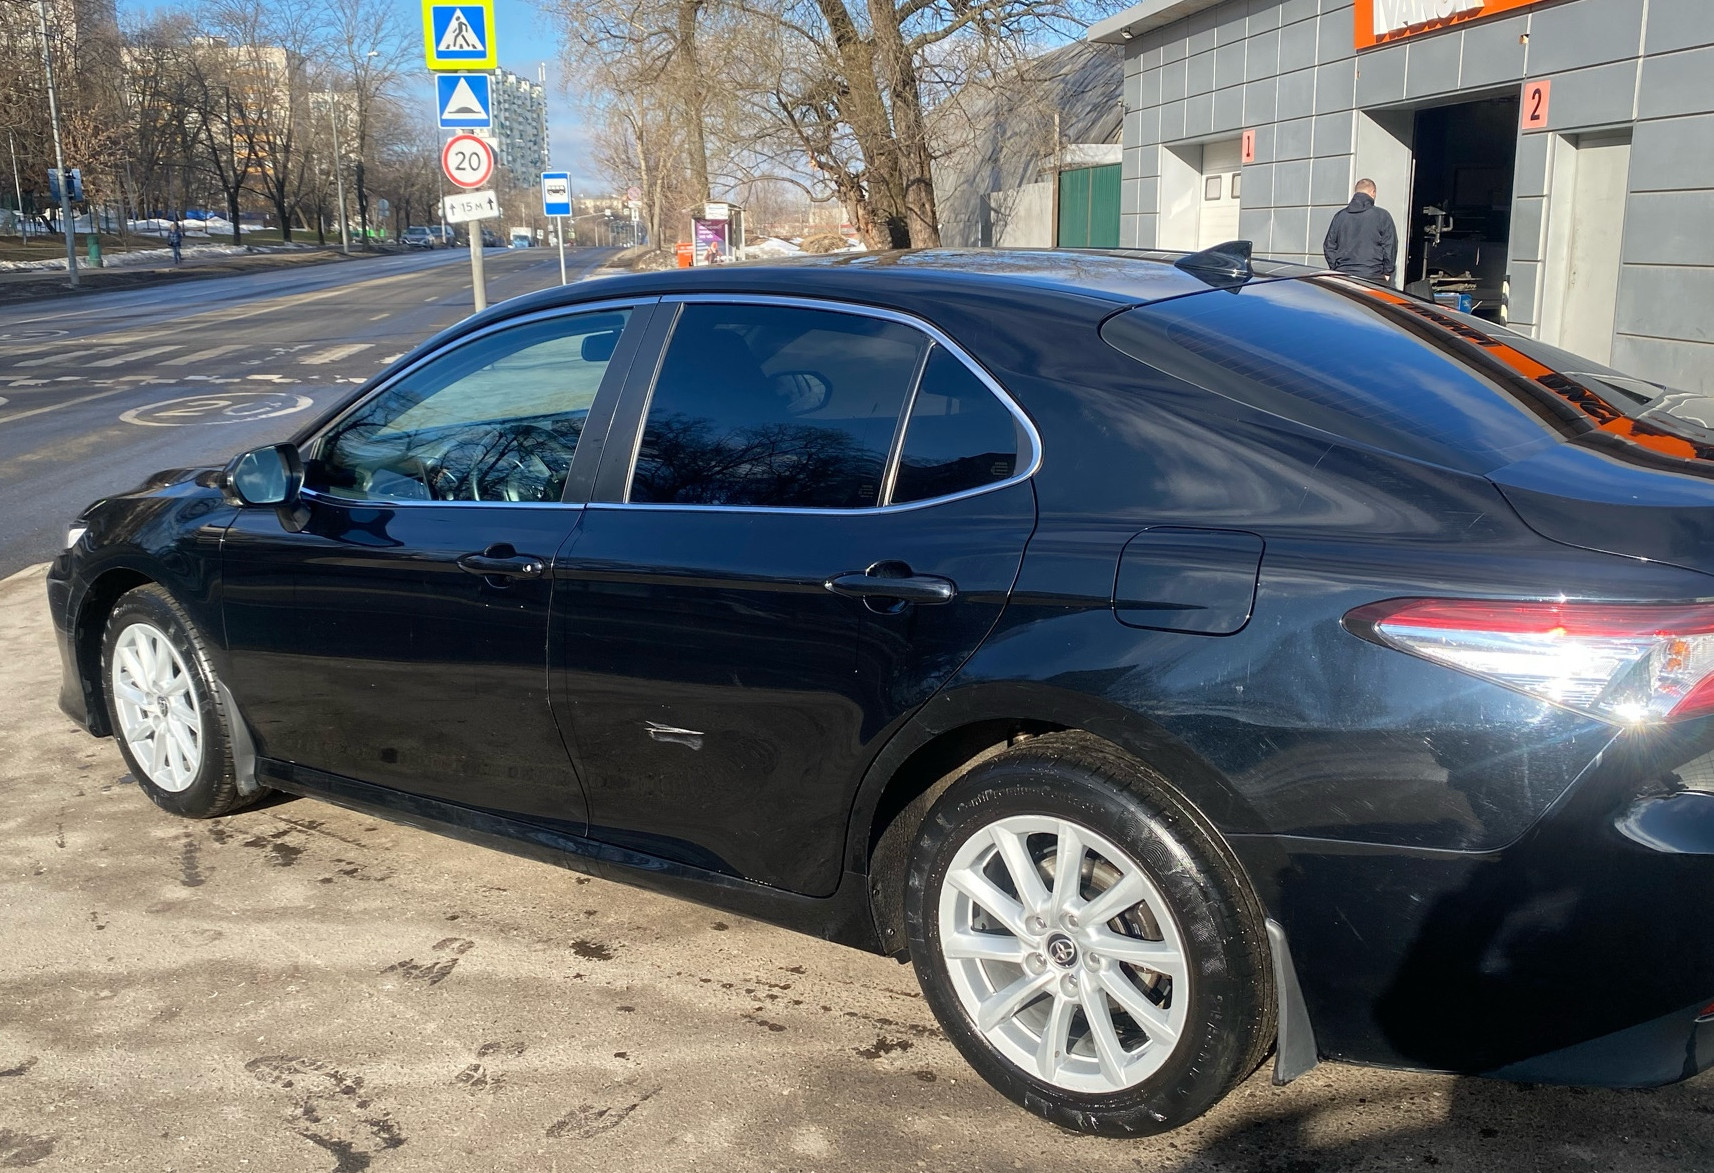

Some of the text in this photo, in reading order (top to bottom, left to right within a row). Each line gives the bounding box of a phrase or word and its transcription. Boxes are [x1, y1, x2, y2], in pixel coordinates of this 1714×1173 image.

[1530, 88, 1542, 121] 2
[1246, 135, 1251, 158] 1
[455, 151, 481, 171] 20
[461, 201, 473, 213] 15
